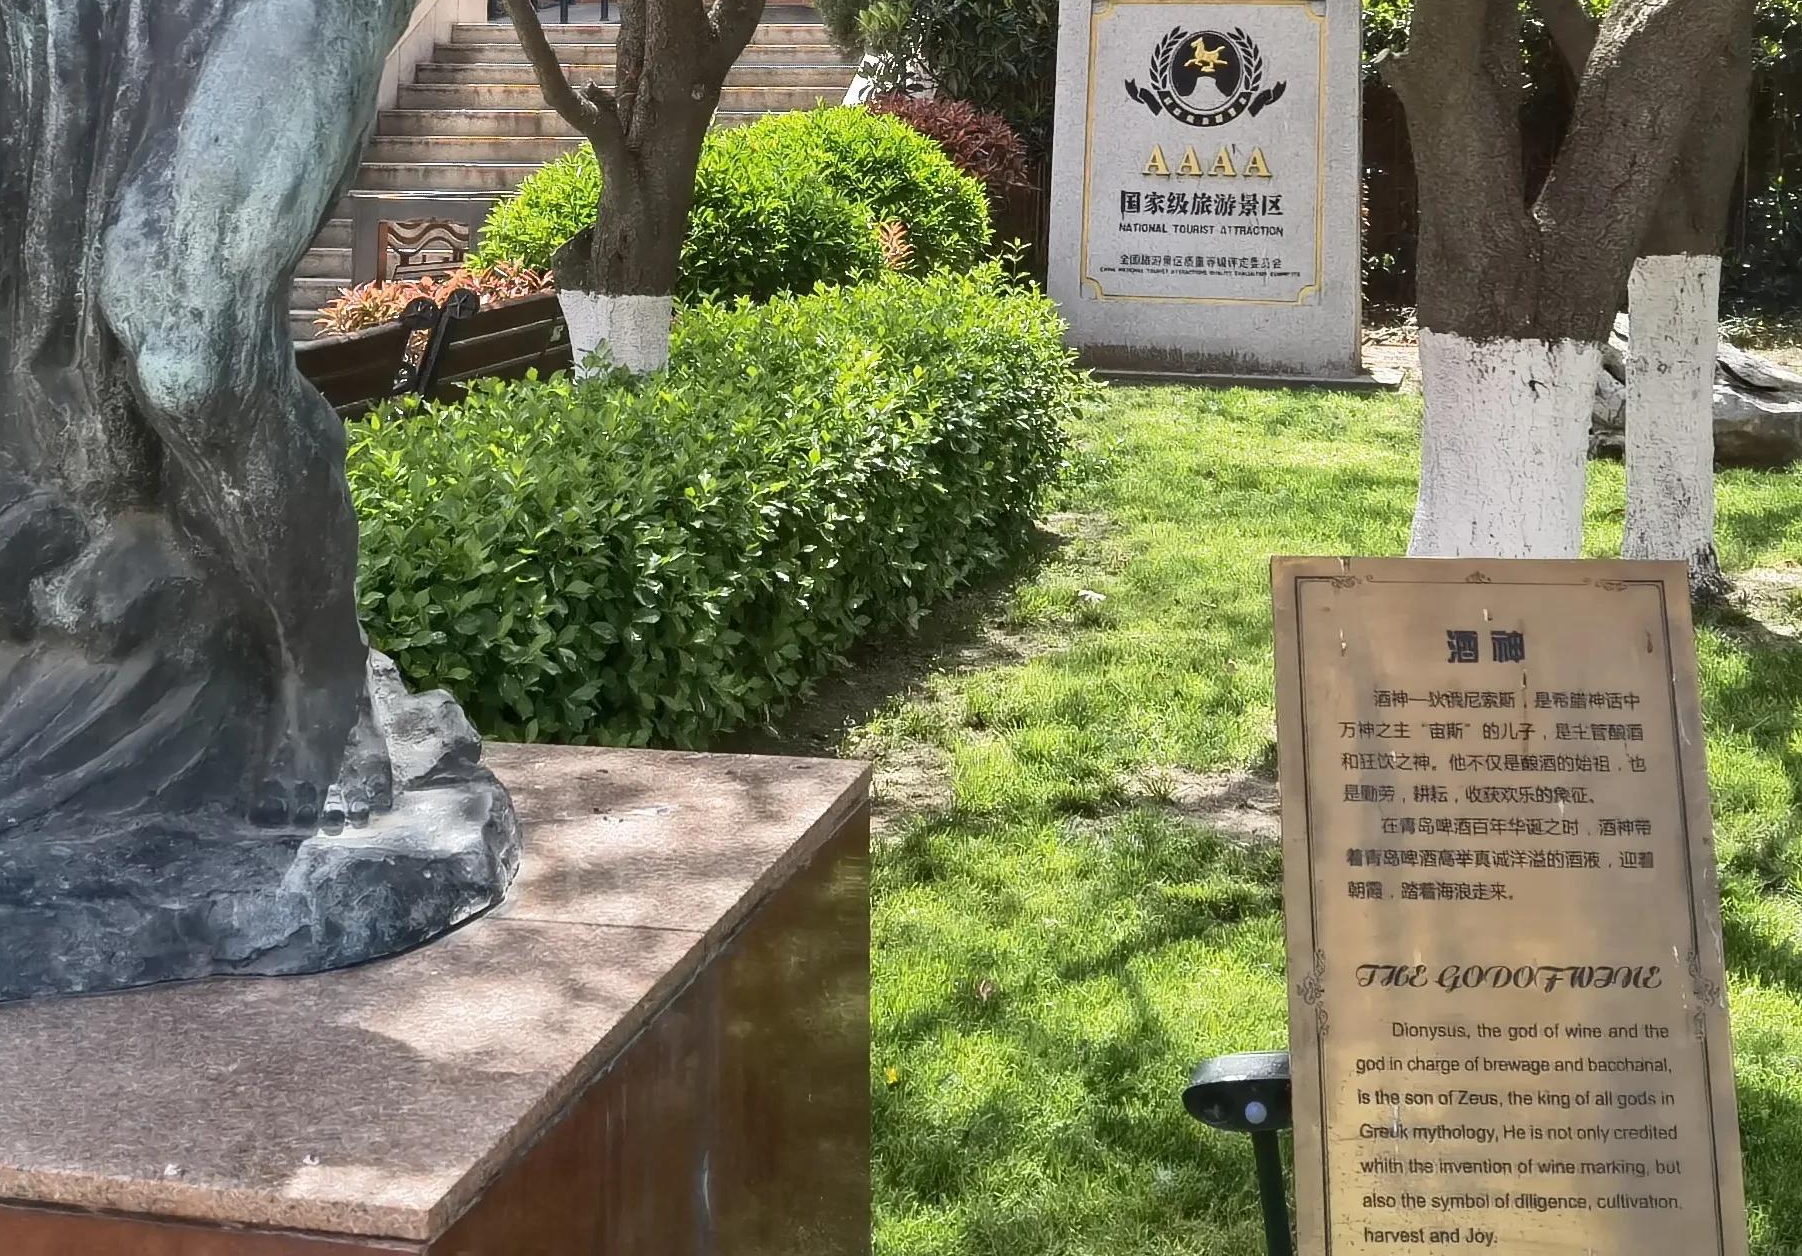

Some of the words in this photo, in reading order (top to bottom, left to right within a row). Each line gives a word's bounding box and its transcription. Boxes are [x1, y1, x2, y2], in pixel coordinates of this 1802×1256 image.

[1142, 144, 1272, 177] AAAA
[1120, 190, 1284, 216] 国家级旅游景区
[1119, 222, 1168, 233] NATIONAL
[1173, 223, 1215, 234] TOURIST
[1220, 225, 1284, 236] ATTRACTION
[1446, 630, 1525, 664] 酒神
[1355, 964, 1429, 988] THE
[1392, 1022, 1471, 1041] Dionysus,
[1477, 1023, 1502, 1039] the
[1508, 1023, 1538, 1042] god
[1543, 1023, 1561, 1039] of
[1565, 1024, 1602, 1039] wine
[1608, 1024, 1638, 1039] and
[1644, 1024, 1670, 1039] the
[1356, 1056, 1385, 1075] god
[1390, 1056, 1403, 1071] in
[1407, 1056, 1460, 1075] charge
[1464, 1056, 1481, 1072] of
[1483, 1056, 1550, 1075] brewage
[1554, 1057, 1584, 1072] and
[1588, 1057, 1672, 1074] bacchanal,
[1357, 1089, 1371, 1104] is
[1375, 1089, 1400, 1105] the
[1404, 1093, 1434, 1105] son
[1438, 1090, 1453, 1105] of
[1457, 1090, 1504, 1107] Zeus,
[1508, 1090, 1533, 1105] the
[1537, 1090, 1571, 1109] king
[1575, 1090, 1590, 1105] of
[1595, 1091, 1613, 1105] all
[1617, 1091, 1657, 1109] gods
[1661, 1092, 1675, 1105] in
[1503, 1124, 1526, 1139] He
[1530, 1124, 1543, 1140] is
[1547, 1125, 1573, 1140] not
[1577, 1124, 1610, 1143] only
[1613, 1124, 1678, 1140] credited
[1360, 1157, 1403, 1174] whith
[1408, 1158, 1434, 1174] the
[1439, 1158, 1512, 1174] invention
[1517, 1158, 1533, 1174] of
[1538, 1159, 1575, 1174] wine
[1581, 1159, 1650, 1178] marking,
[1655, 1159, 1682, 1175] but
[1362, 1193, 1397, 1208] also
[1401, 1193, 1426, 1208] the
[1431, 1192, 1490, 1212] symbol
[1494, 1193, 1510, 1208] of
[1515, 1194, 1592, 1212] diligence,
[1364, 1226, 1425, 1243] harvest
[1429, 1227, 1460, 1244] and
[1465, 1227, 1497, 1247] Joy.
